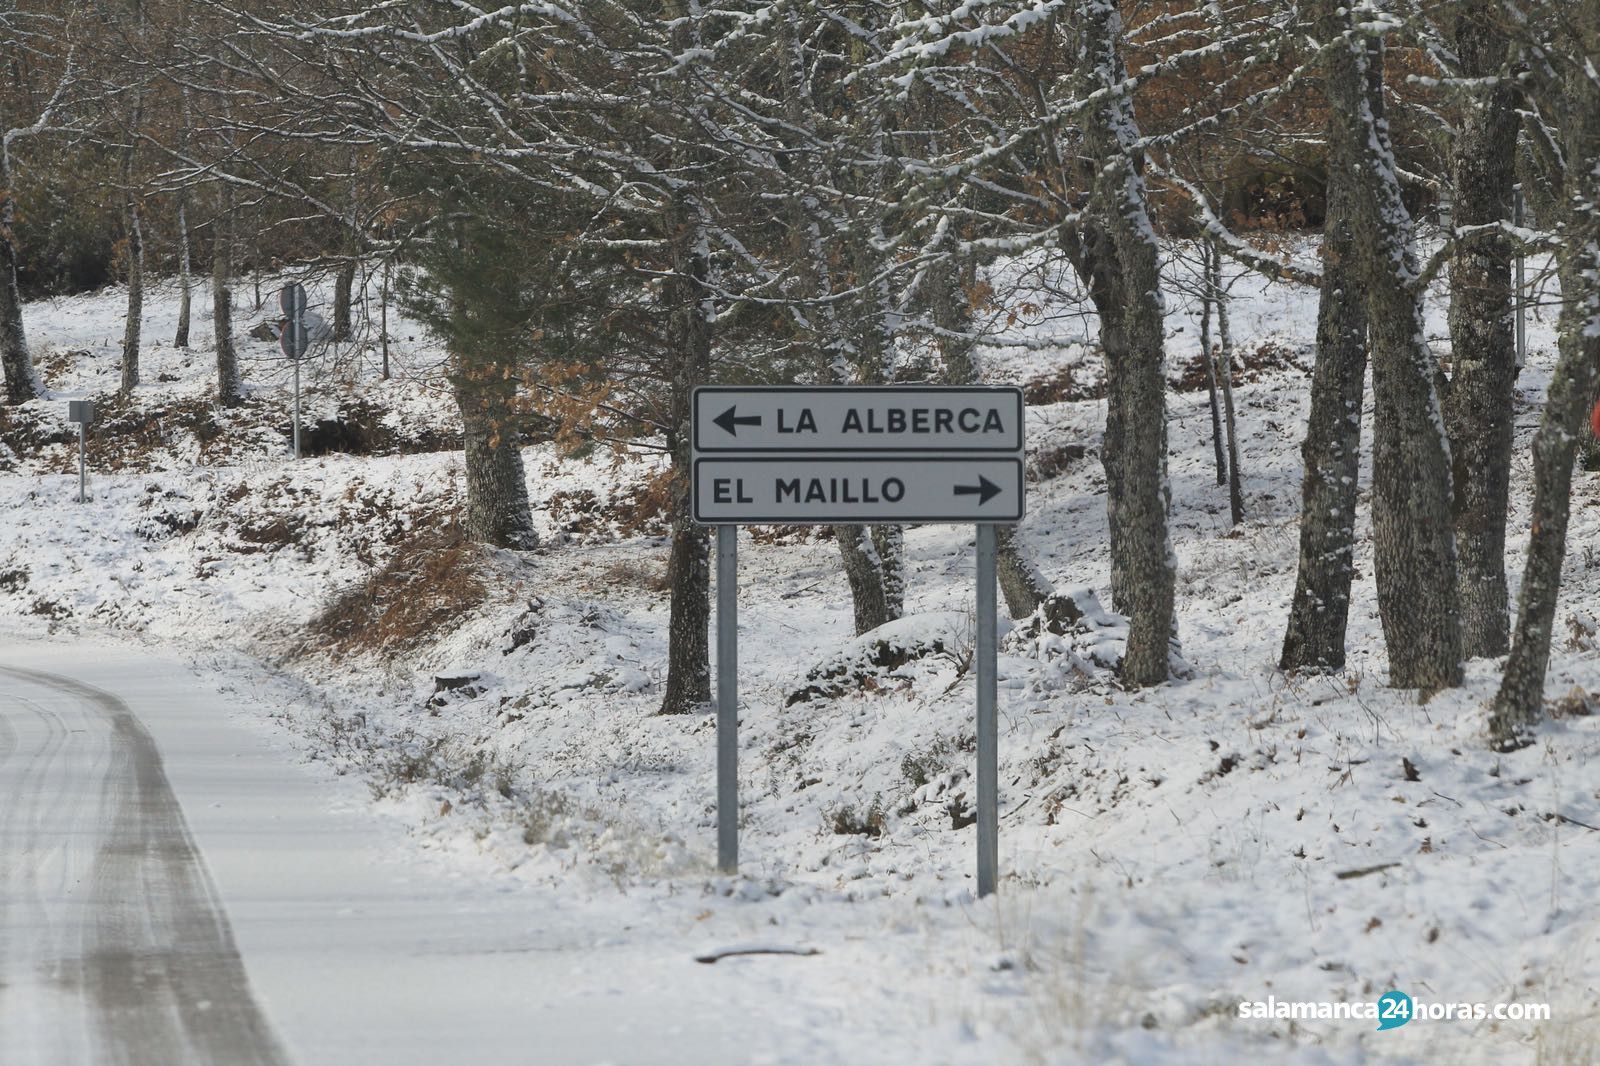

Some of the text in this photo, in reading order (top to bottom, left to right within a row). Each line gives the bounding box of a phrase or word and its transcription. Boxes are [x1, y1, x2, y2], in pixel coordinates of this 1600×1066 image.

[776, 408, 1005, 434] LA ALBERCA
[713, 477, 906, 504] EL MAILLO
